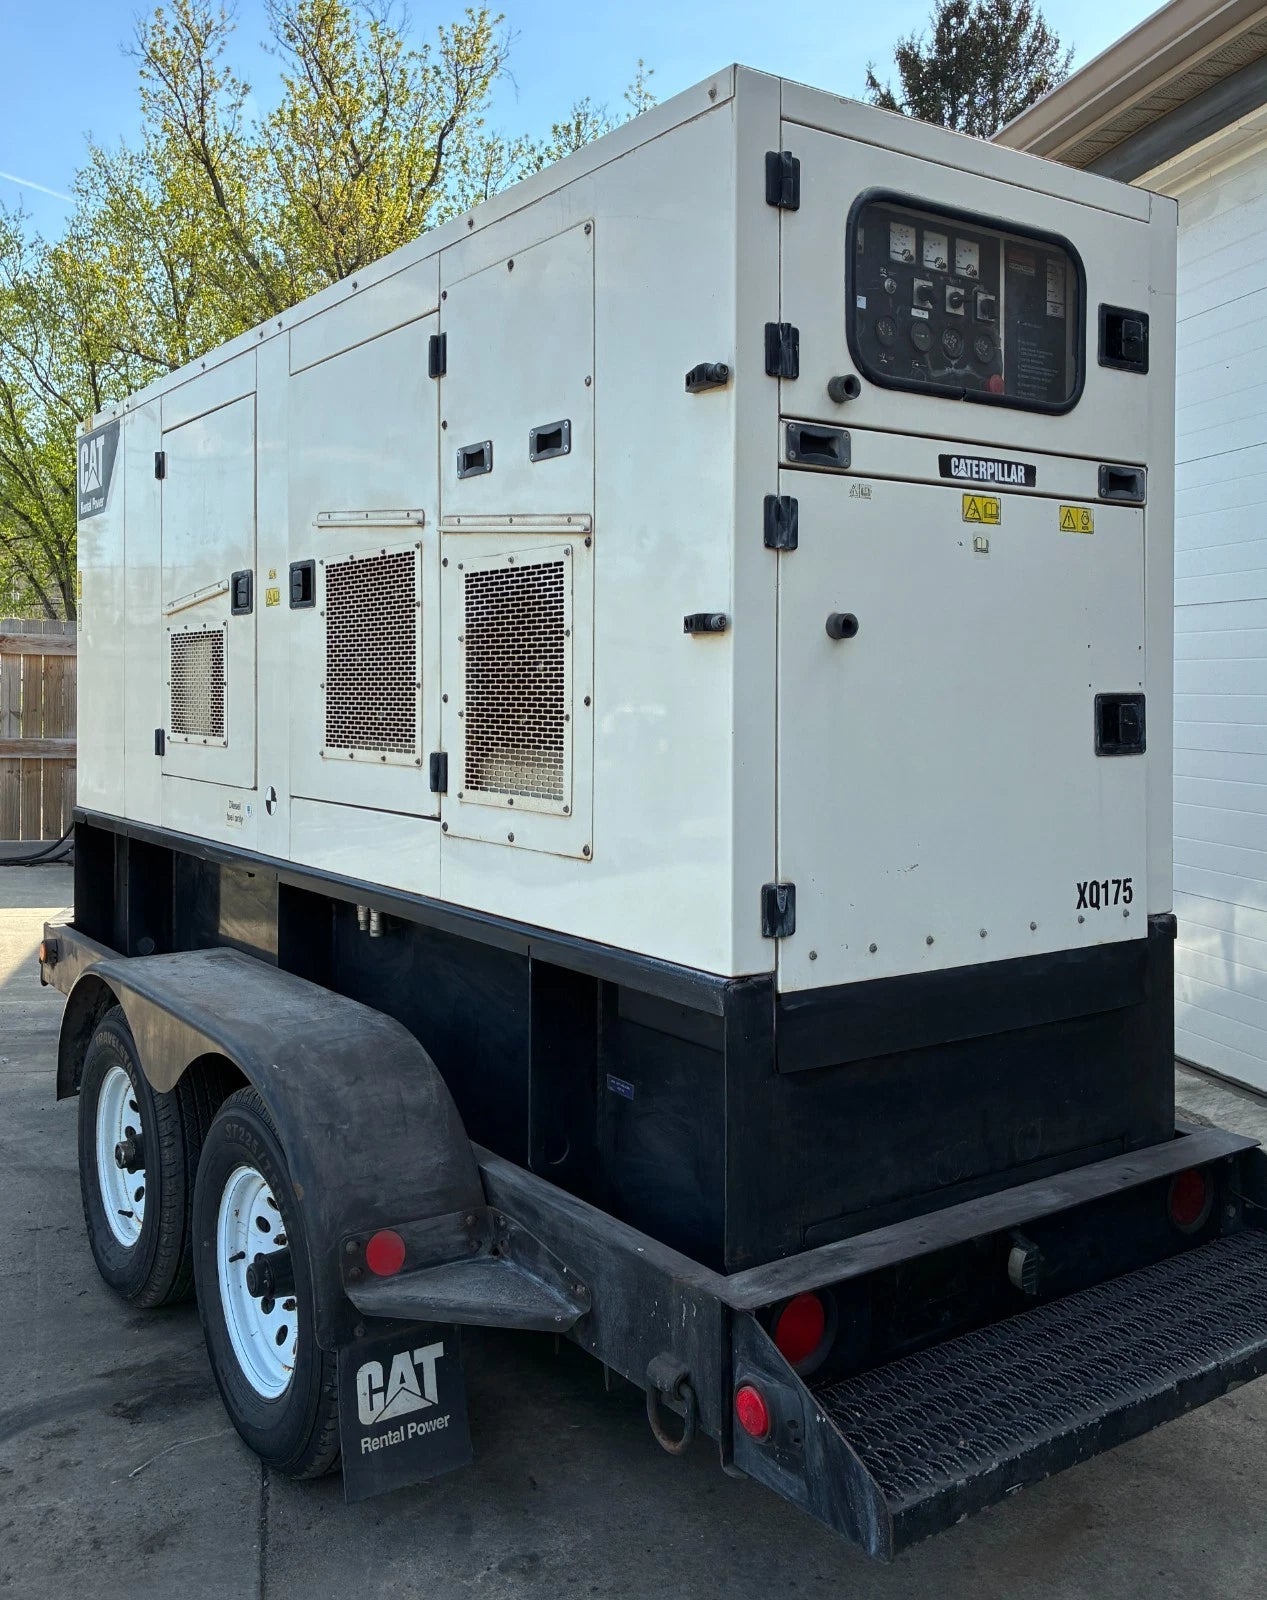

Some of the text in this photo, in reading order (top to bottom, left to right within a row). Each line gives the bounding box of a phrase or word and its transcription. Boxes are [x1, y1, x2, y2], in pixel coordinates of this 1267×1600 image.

[81, 434, 105, 494] CAT
[951, 457, 1026, 484] CATERPILLAR
[81, 497, 104, 514] Rental Power
[229, 800, 241, 810] Diesel
[235, 814, 243, 825] only
[1076, 878, 1133, 911] XQ175
[356, 1341, 444, 1426] CAT
[360, 1414, 451, 1455] Rental Power
